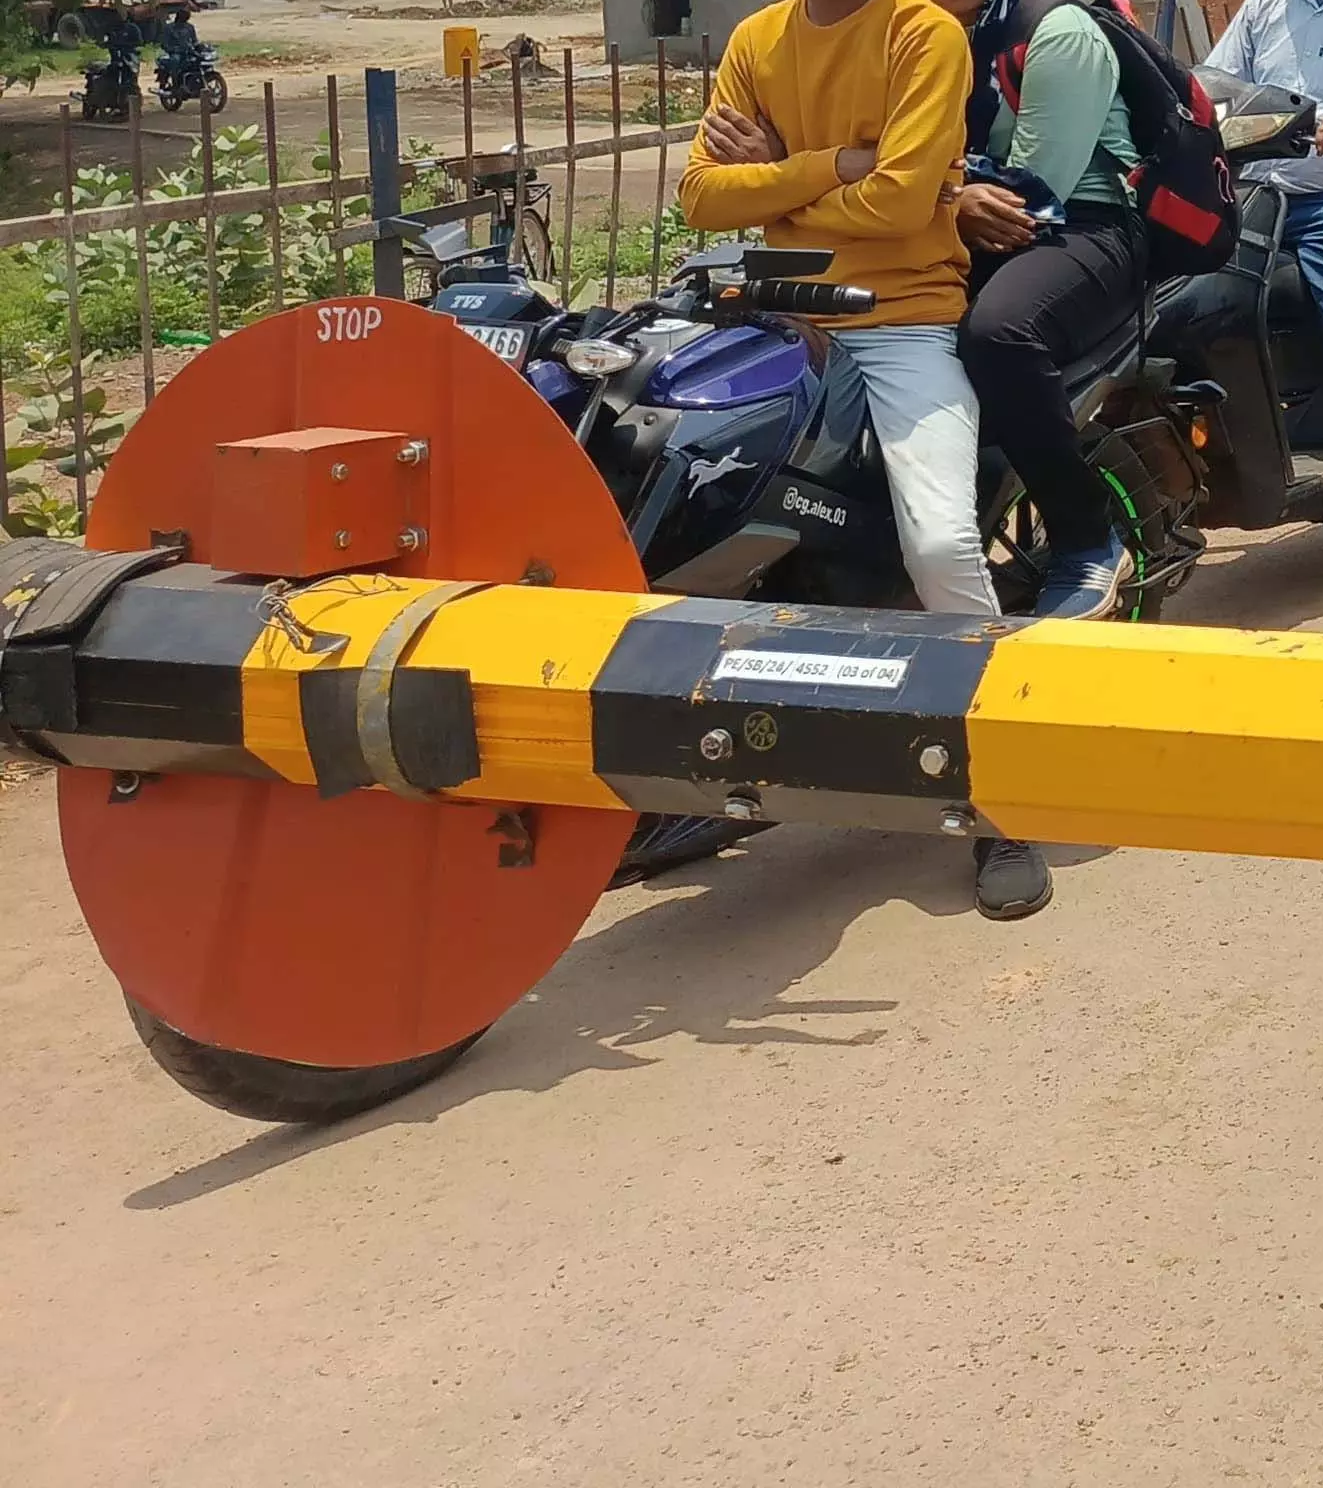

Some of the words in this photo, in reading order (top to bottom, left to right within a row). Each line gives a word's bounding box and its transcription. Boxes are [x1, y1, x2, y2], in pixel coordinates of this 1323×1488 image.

[450, 294, 487, 310] TVS
[316, 306, 381, 342] STOP
[795, 662, 829, 675] 4552
[837, 664, 858, 679] (03
[860, 666, 875, 679] of
[877, 667, 900, 682] 04)
